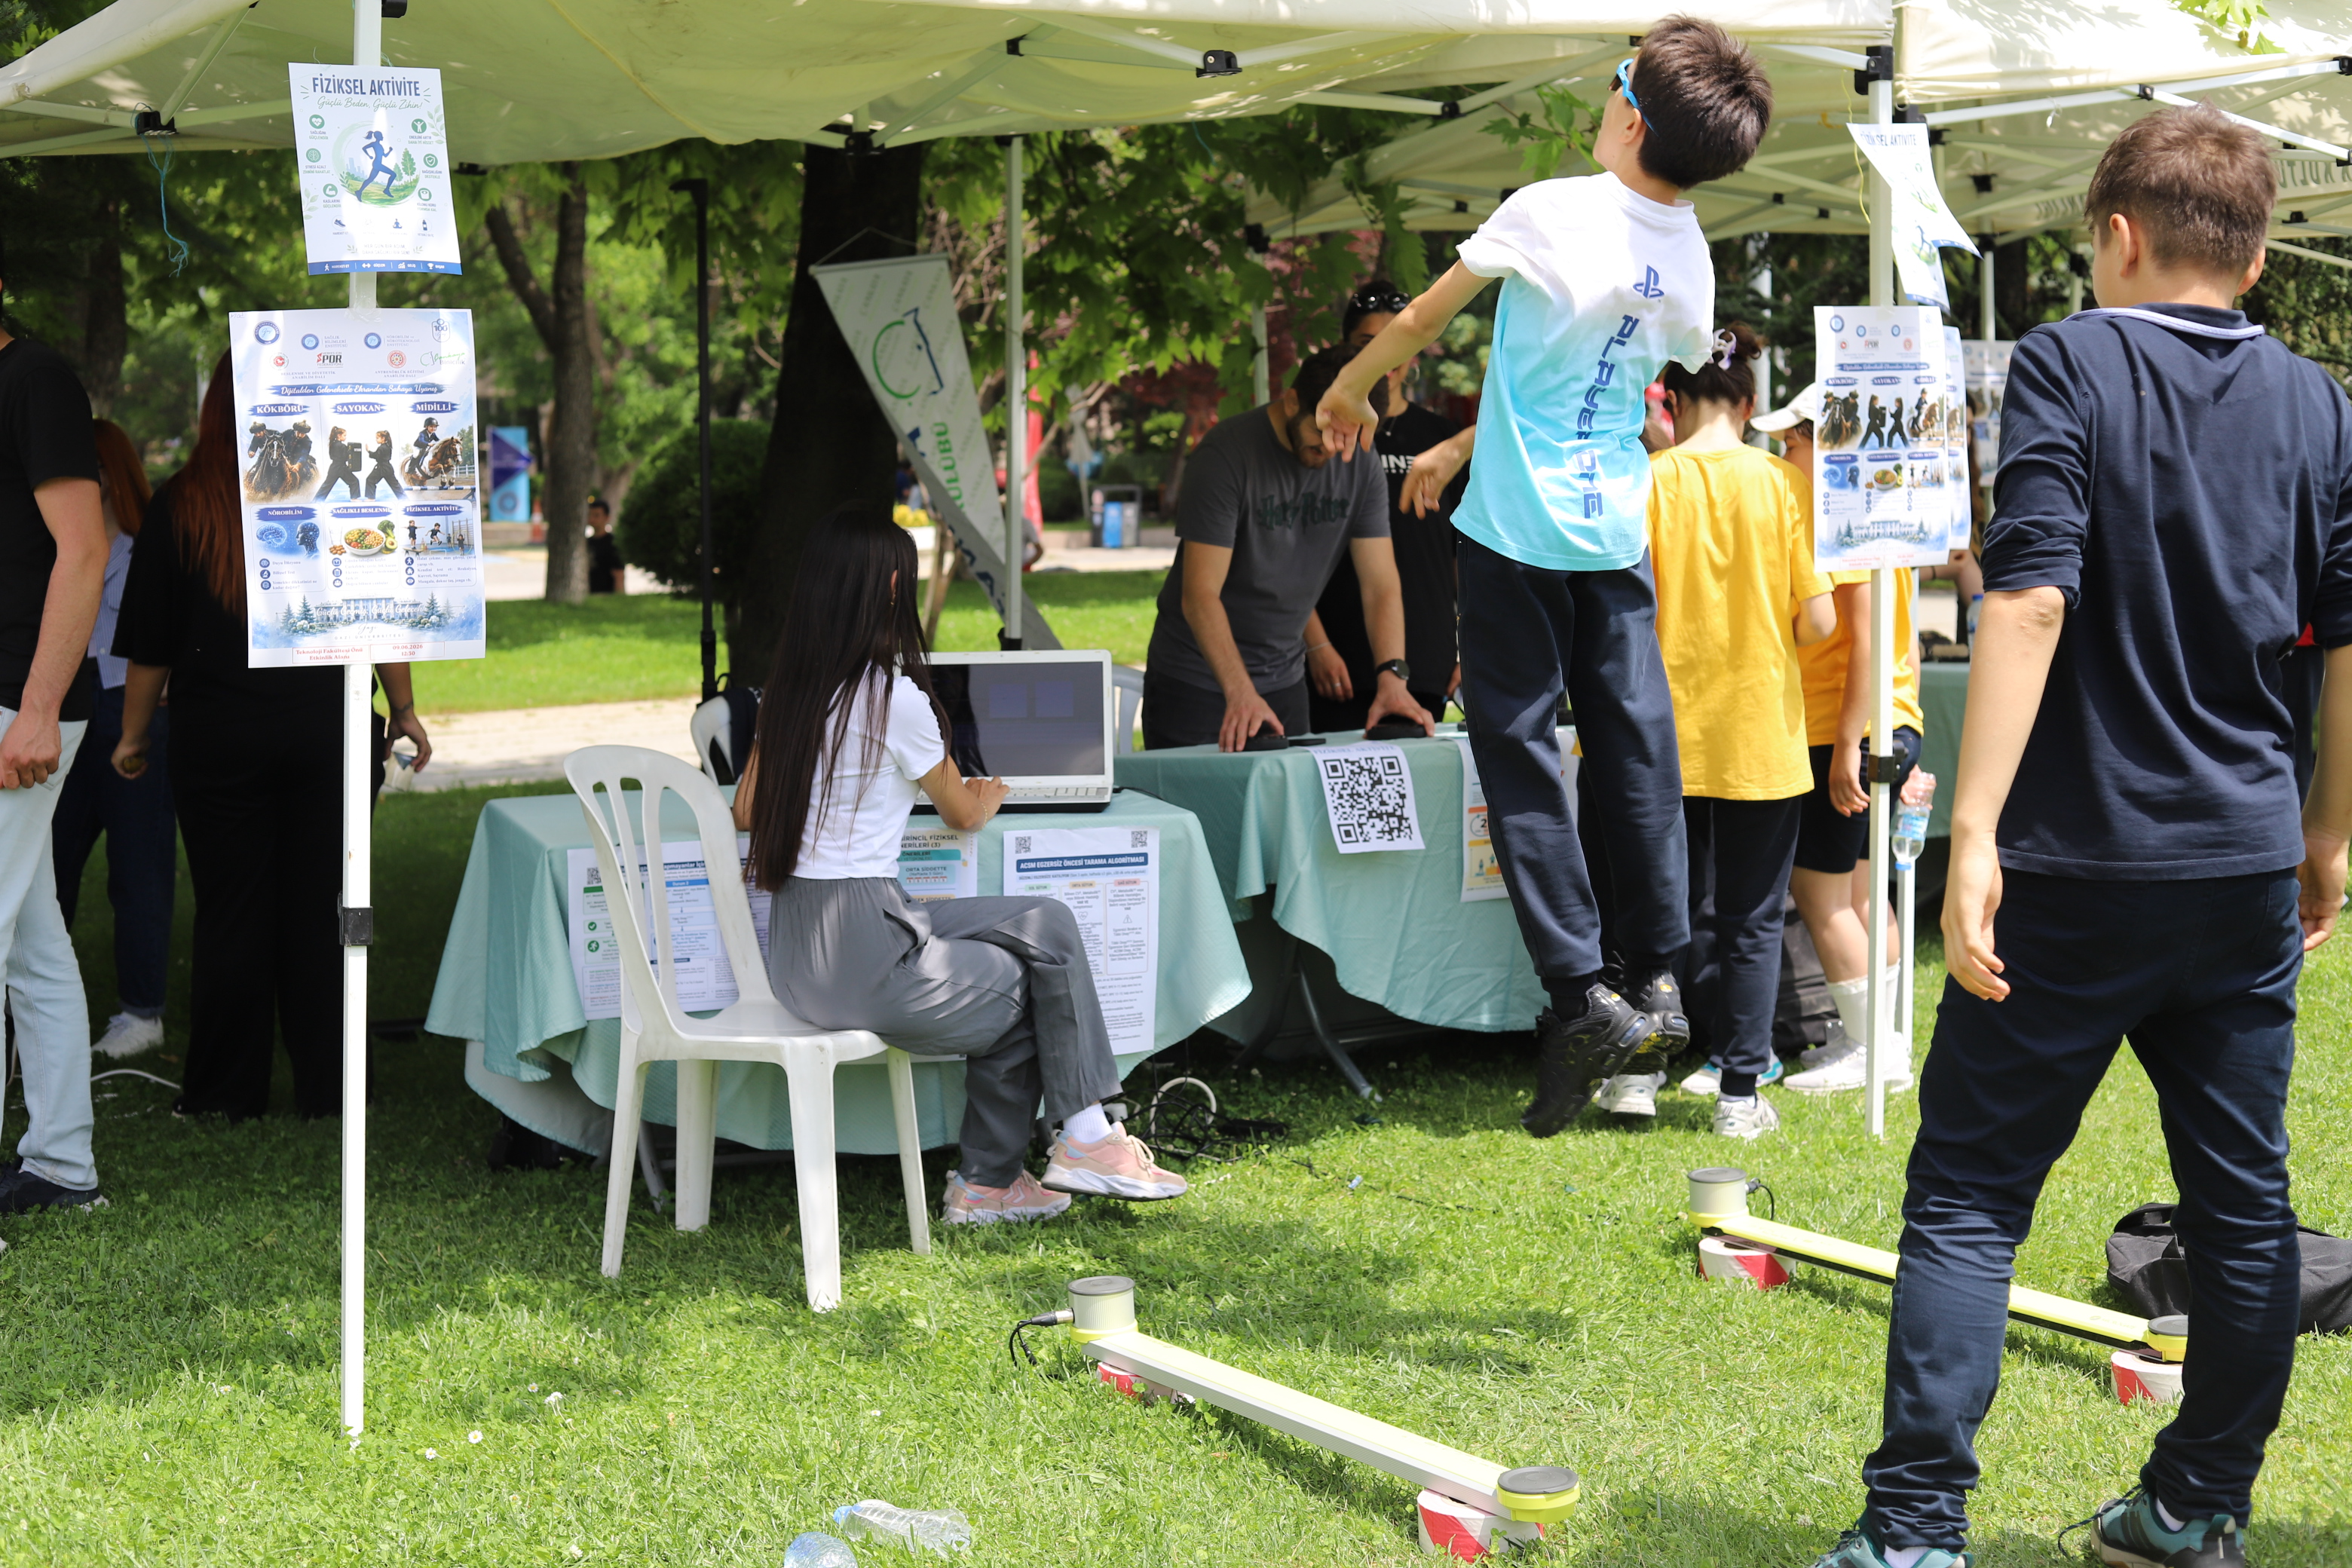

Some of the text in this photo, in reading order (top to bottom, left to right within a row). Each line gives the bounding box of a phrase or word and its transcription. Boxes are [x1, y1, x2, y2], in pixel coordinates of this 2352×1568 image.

[312, 73, 421, 96] FİZİKSEL AKTİVİTE
[317, 96, 423, 112] Güçlü Beden, Güçlü Zihin!
[317, 352, 342, 364] SPOR
[281, 386, 314, 395] Dijitalden
[316, 385, 353, 394] Geleneksele
[388, 384, 413, 393] Sahaya
[256, 403, 304, 414] KÖKBÖRÜ
[336, 404, 381, 412] SAYOKAN
[415, 402, 452, 412] MİDİLLİ
[1301, 491, 1349, 534] Potter
[317, 607, 338, 617] Güçlü
[372, 605, 394, 615] Güçlü
[323, 647, 350, 655] Fakültesi
[1107, 856, 1144, 865] ALGORİTMASI
